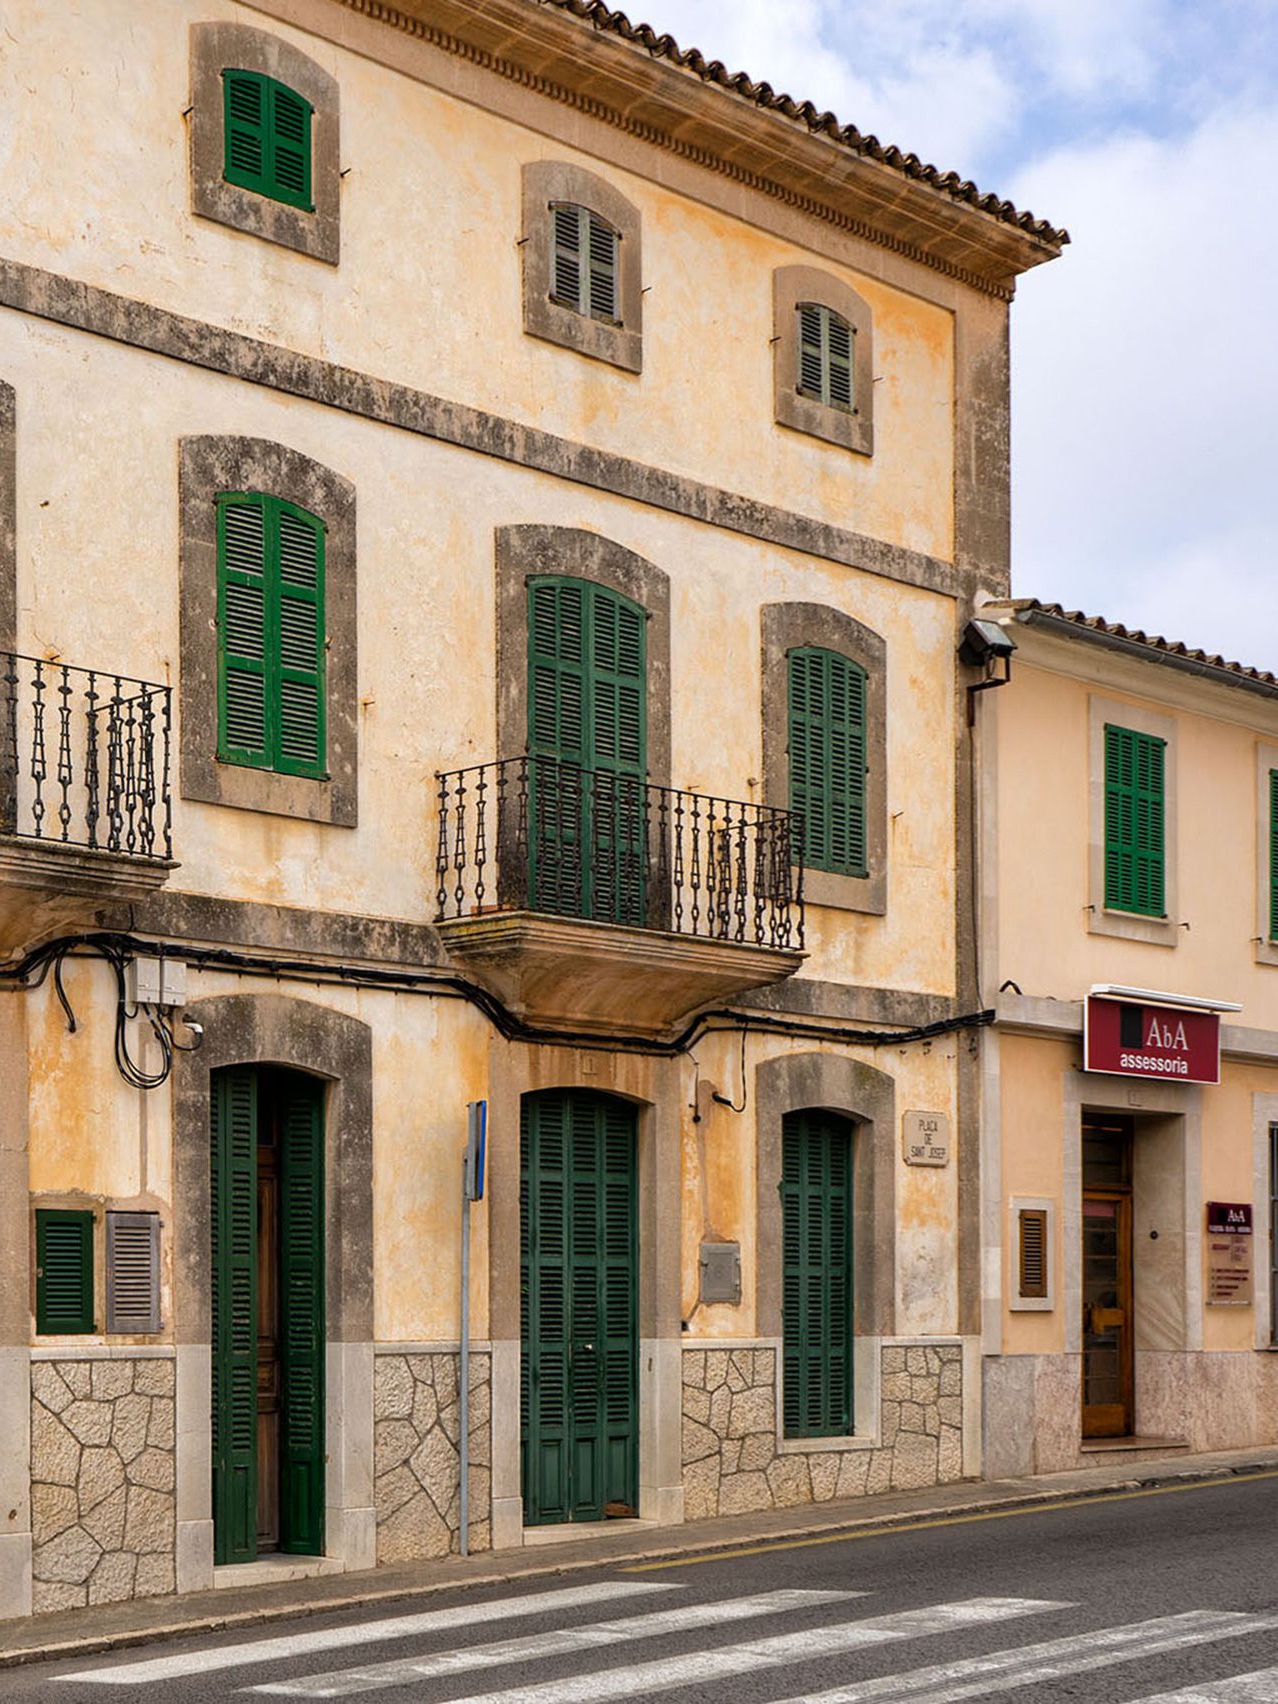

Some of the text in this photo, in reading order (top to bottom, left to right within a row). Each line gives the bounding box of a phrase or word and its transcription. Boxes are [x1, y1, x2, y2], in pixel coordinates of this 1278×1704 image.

[1146, 1016, 1189, 1051] AbA
[1120, 1053, 1188, 1075] assessoria
[924, 1132, 932, 1145] DE
